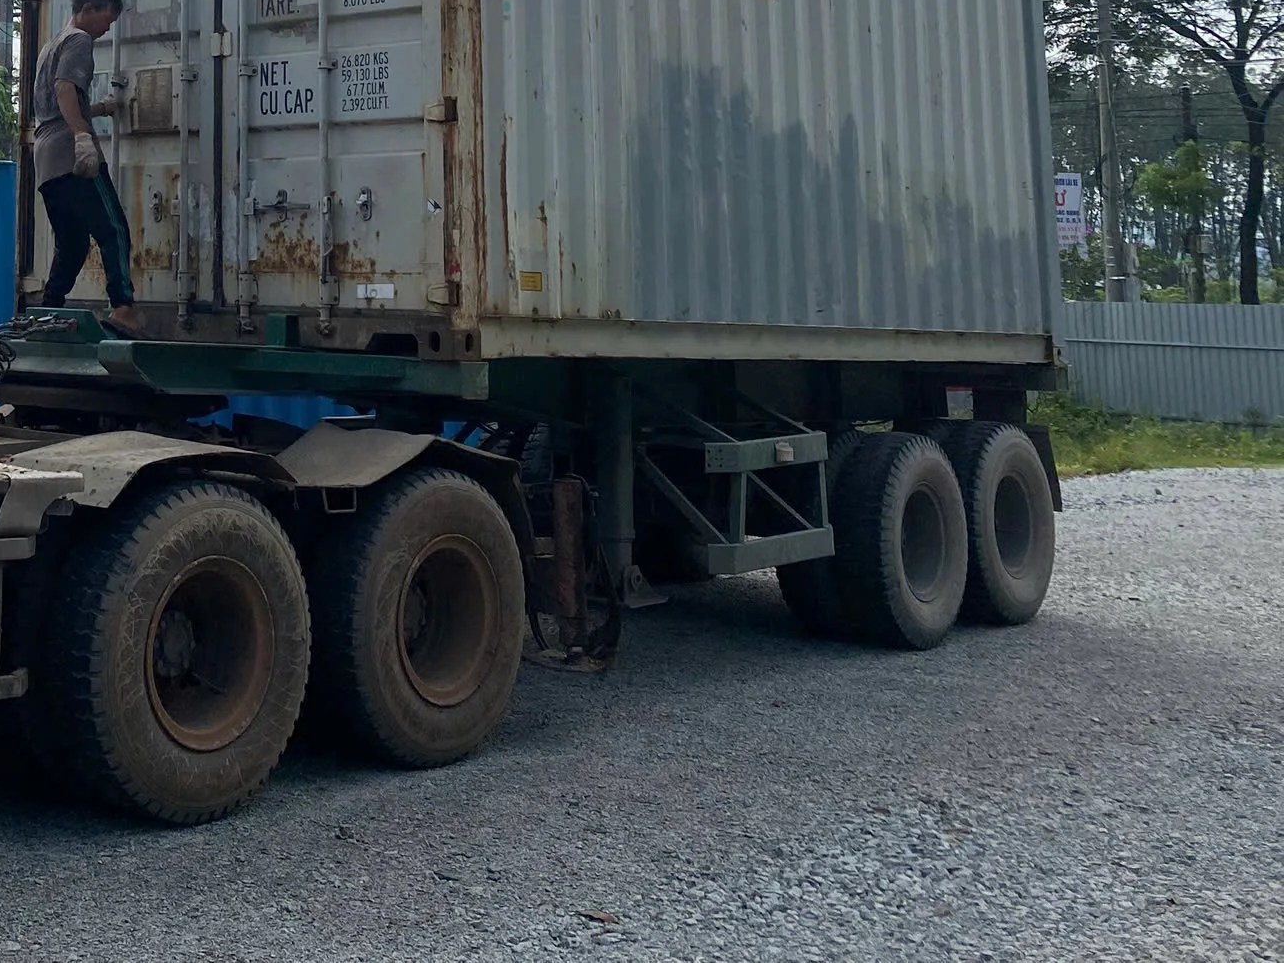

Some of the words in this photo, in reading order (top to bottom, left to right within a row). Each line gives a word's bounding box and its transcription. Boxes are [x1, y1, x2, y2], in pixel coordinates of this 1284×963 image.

[341, 53, 370, 68] 26.820
[373, 51, 389, 66] KGS
[260, 61, 292, 87] NET.
[341, 68, 371, 83] 59.130
[373, 67, 389, 80] LBS
[346, 84, 366, 97] 67.7
[342, 98, 366, 112] 2.392
